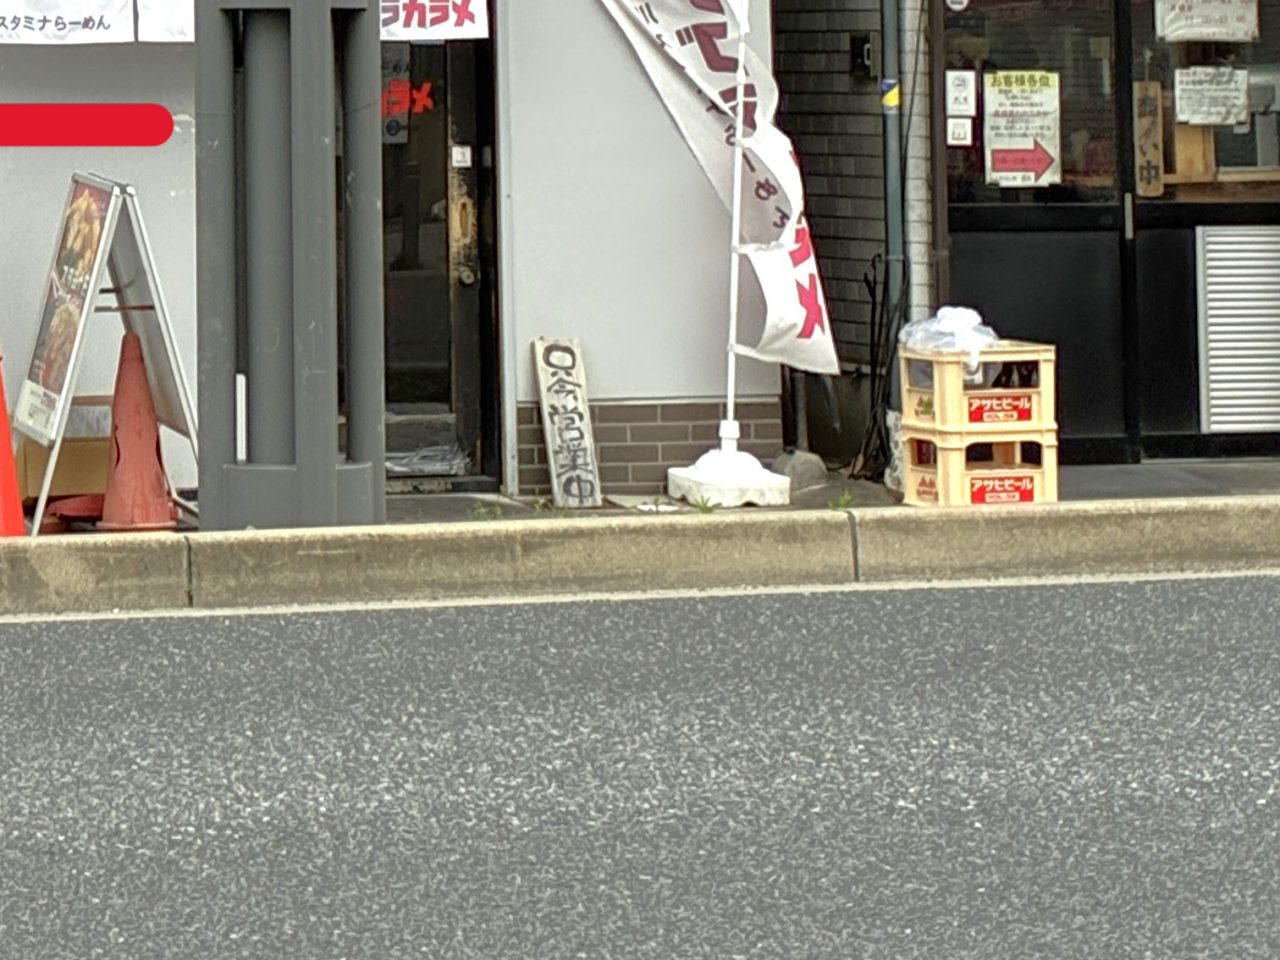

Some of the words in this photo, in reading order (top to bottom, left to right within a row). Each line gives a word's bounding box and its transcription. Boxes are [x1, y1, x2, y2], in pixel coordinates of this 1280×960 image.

[970, 396, 1031, 411] アサヒビール
[972, 478, 1033, 491] アサヒビール
